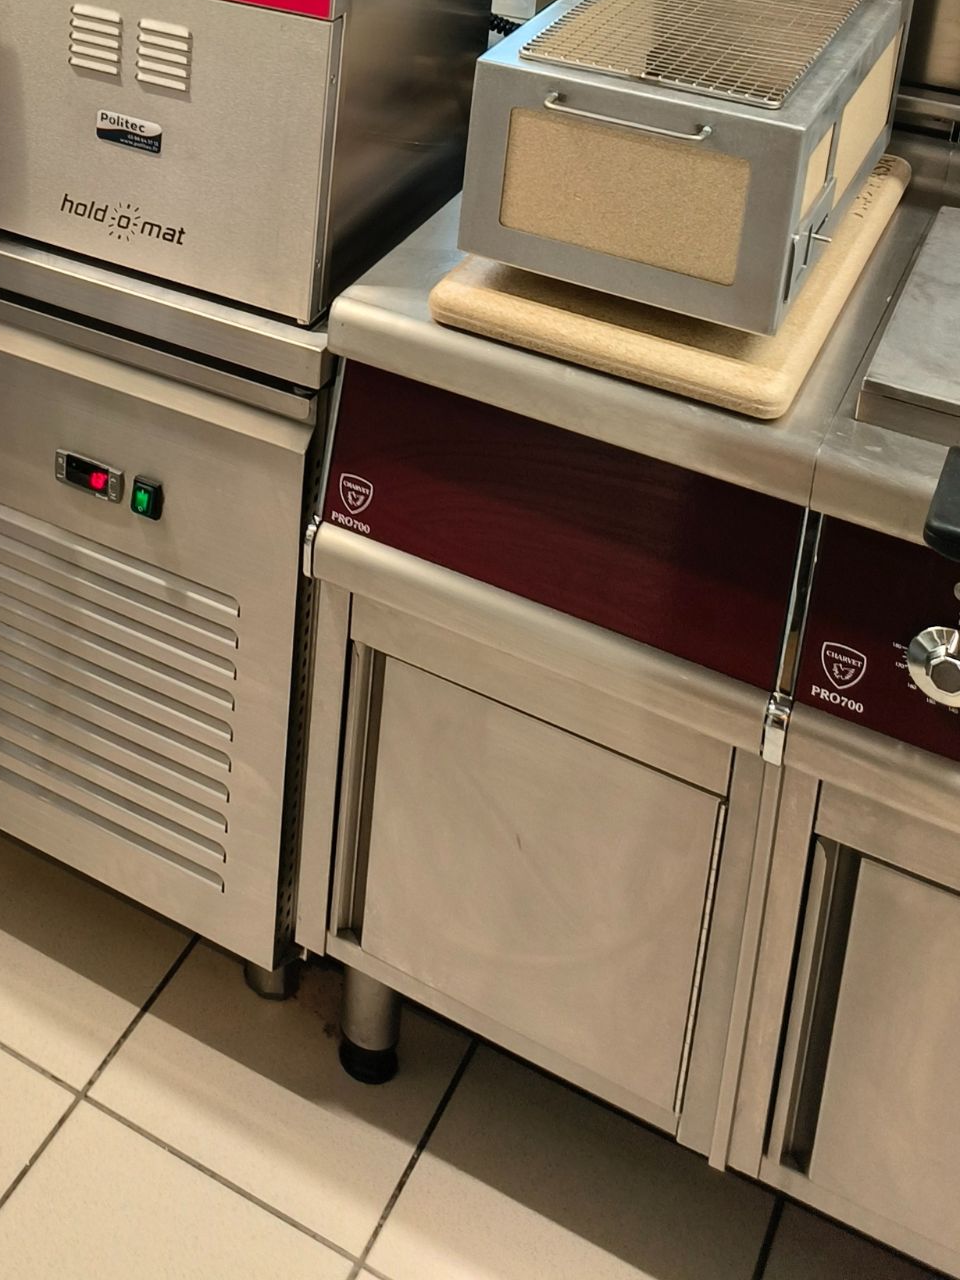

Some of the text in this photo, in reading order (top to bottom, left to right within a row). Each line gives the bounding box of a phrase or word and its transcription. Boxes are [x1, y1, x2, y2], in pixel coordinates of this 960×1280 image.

[100, 112, 145, 133] Politec
[331, 510, 371, 534] PRO700
[826, 649, 863, 668] CHARVET
[811, 684, 864, 713] PRO700
